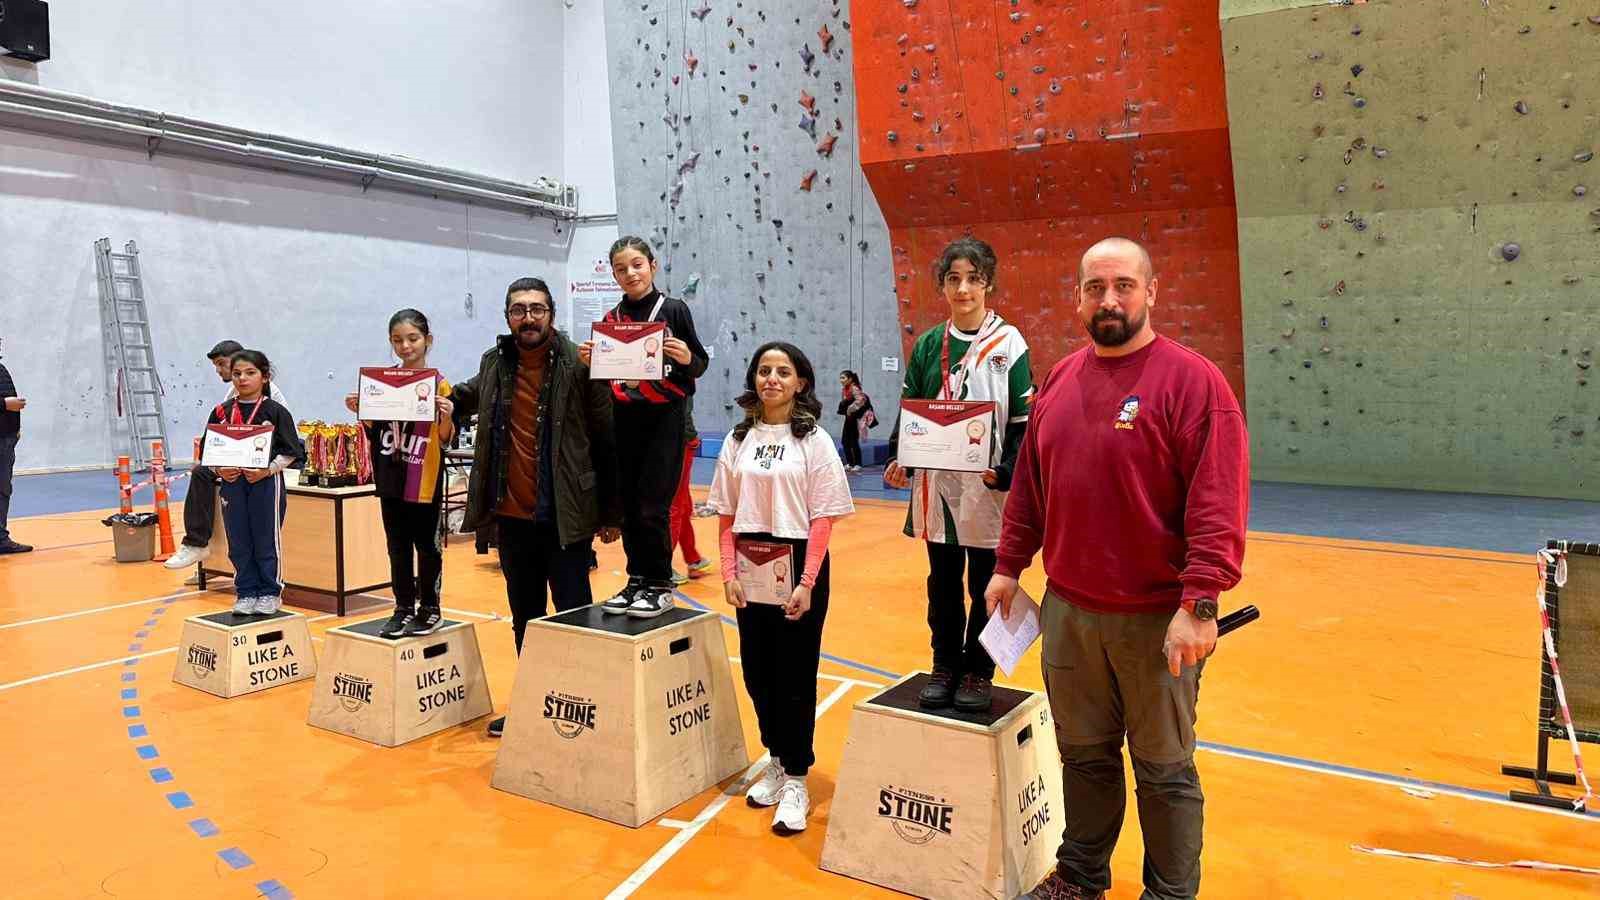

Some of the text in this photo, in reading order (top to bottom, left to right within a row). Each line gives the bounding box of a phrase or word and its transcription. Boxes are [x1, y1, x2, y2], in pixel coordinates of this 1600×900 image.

[232, 634, 247, 647] 30
[187, 646, 217, 671] STONE
[247, 644, 294, 666] LIKE A
[400, 649, 414, 661] 40
[640, 647, 654, 662] 60
[250, 662, 299, 686] STONE
[416, 664, 461, 690] LIKE A
[333, 675, 373, 705] STONE
[419, 684, 465, 713] STONE
[666, 679, 706, 709] LIKE A
[544, 695, 597, 729] STONE
[669, 702, 710, 736] STONE
[1039, 709, 1049, 726] 50
[1017, 774, 1046, 814] LIKE A
[878, 789, 953, 834] STONE
[1021, 802, 1050, 846] STONE
